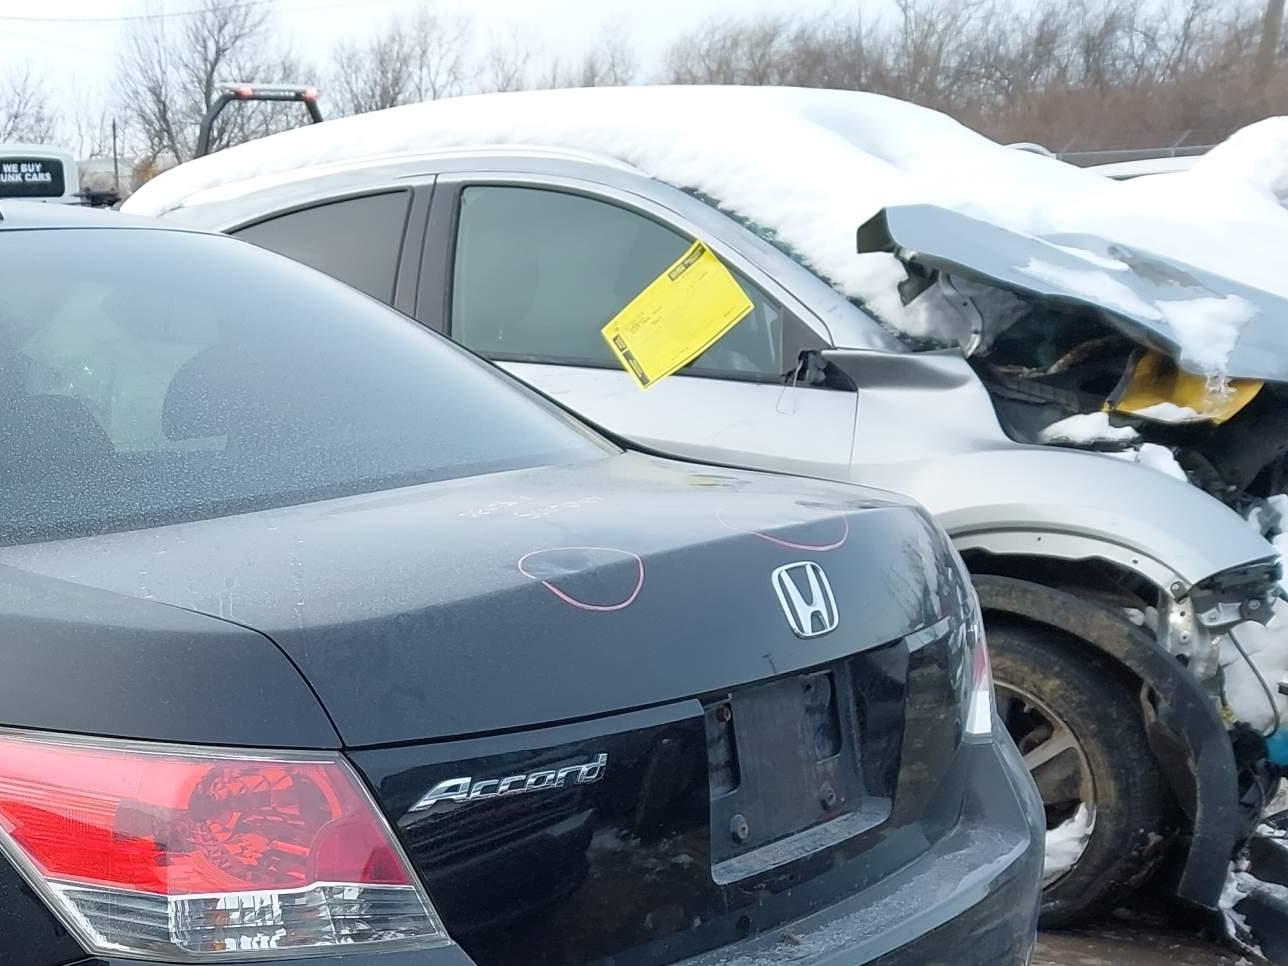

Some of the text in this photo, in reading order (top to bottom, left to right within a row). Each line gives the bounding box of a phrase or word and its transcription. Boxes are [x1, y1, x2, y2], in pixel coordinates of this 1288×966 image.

[2, 163, 42, 172] WE BUY
[24, 172, 51, 182] CARS
[408, 752, 608, 812] Accord
